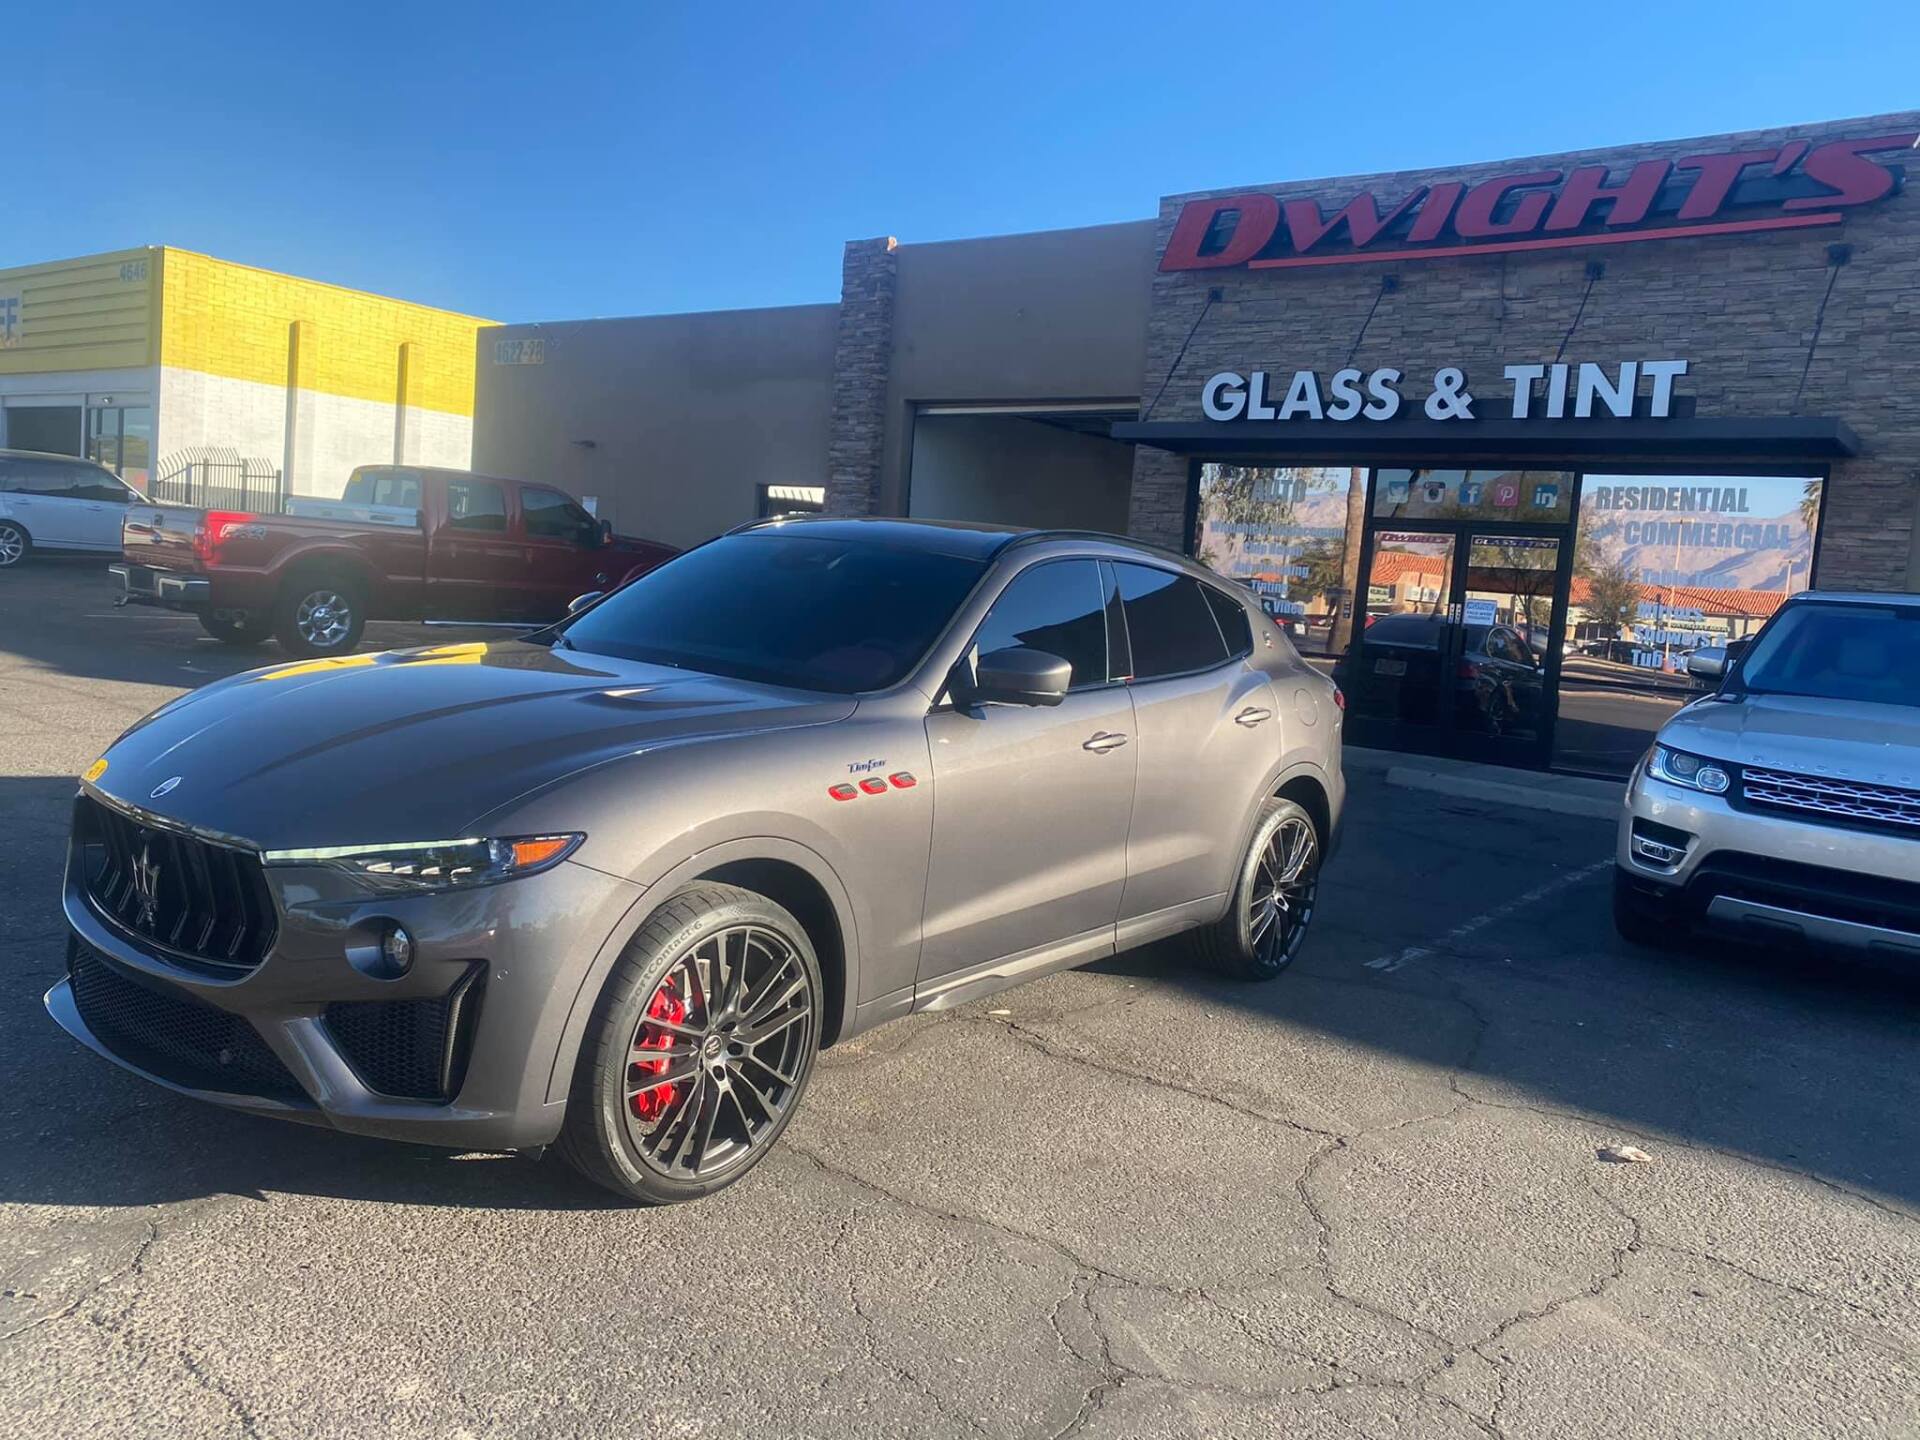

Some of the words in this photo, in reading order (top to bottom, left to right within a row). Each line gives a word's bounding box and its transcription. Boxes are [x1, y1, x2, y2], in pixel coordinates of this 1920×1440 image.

[1159, 132, 1917, 272] DWIGHT'S
[1201, 369, 1402, 423] GLASS
[1424, 367, 1476, 421] &
[1504, 359, 1689, 420] TINT
[1250, 478, 1307, 503] AUTO
[1595, 486, 1750, 513] RESIDENTIAL
[1623, 520, 1791, 550] COMMERCIAL
